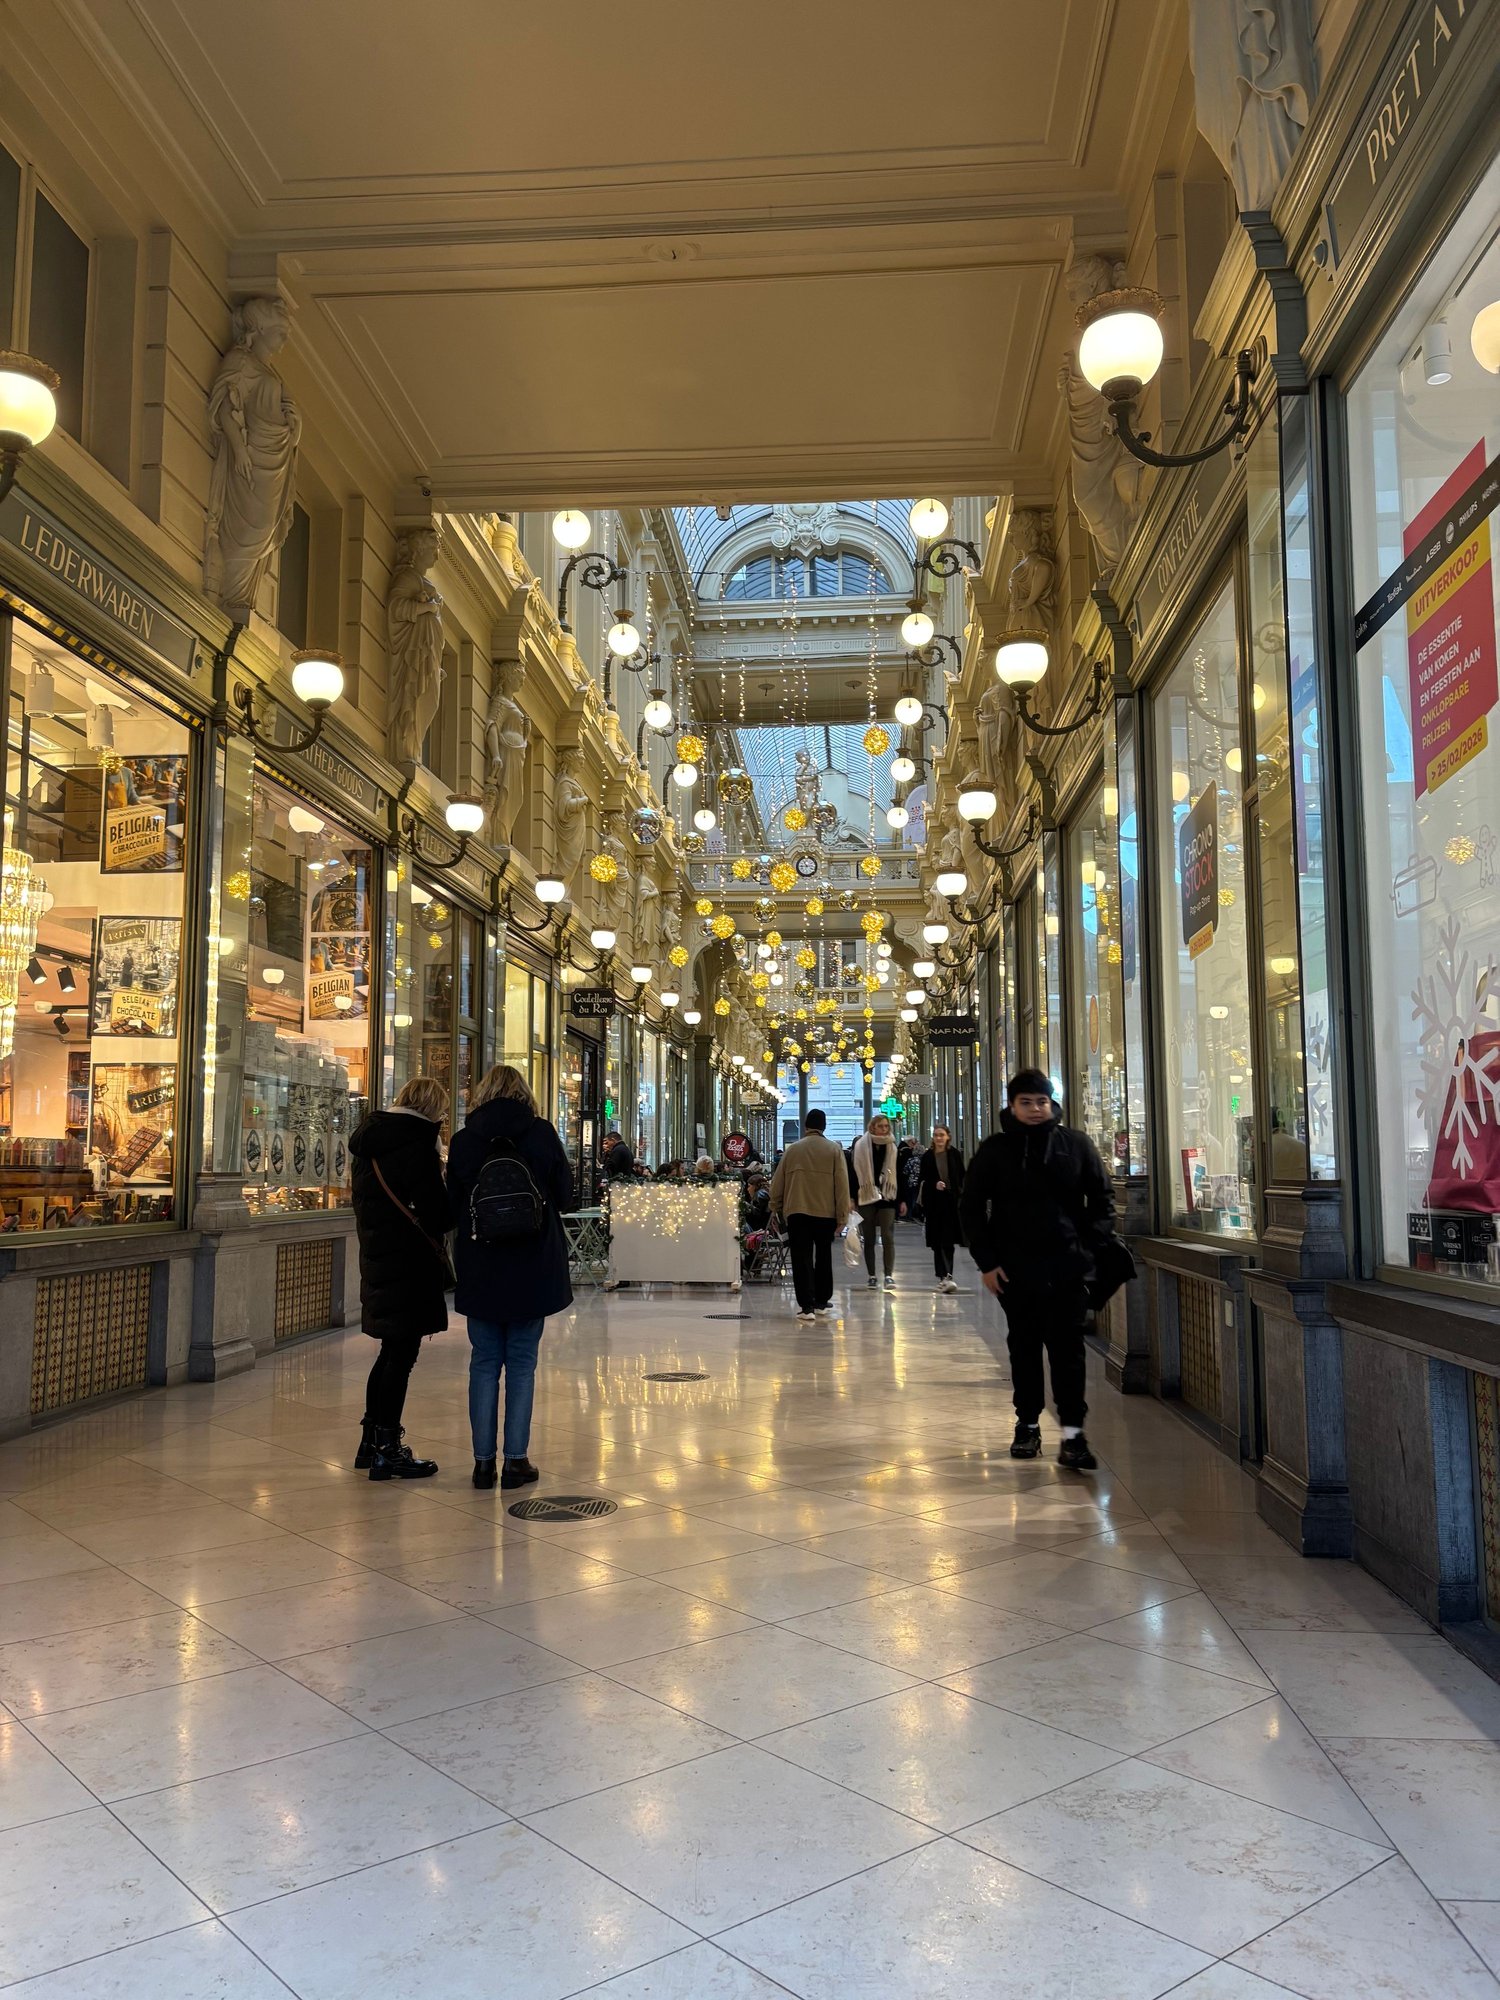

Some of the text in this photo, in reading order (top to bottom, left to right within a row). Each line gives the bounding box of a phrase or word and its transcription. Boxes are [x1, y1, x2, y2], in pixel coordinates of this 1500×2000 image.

[1367, 4, 1452, 185] PRET A
[1158, 490, 1202, 594] CONFECTIE
[21, 514, 154, 640] LEDERWAREN
[1415, 541, 1479, 617] UITVERKOOP
[1417, 615, 1463, 665] DE ESSENTIE
[1419, 641, 1460, 686] VAN KOKEN
[1419, 646, 1481, 708] EN FEESTEN AAN
[1421, 680, 1470, 728] ONKLOPBARE
[1422, 722, 1451, 750] PRIJZEN
[1437, 728, 1483, 777] 25/02/2026
[1184, 823, 1213, 867] CHRONO
[1185, 852, 1214, 899] STOCK
[108, 926, 145, 941] ARTISAN
[116, 1006, 156, 1020] CHOCOLATE
[579, 1003, 608, 1013] du Roi
